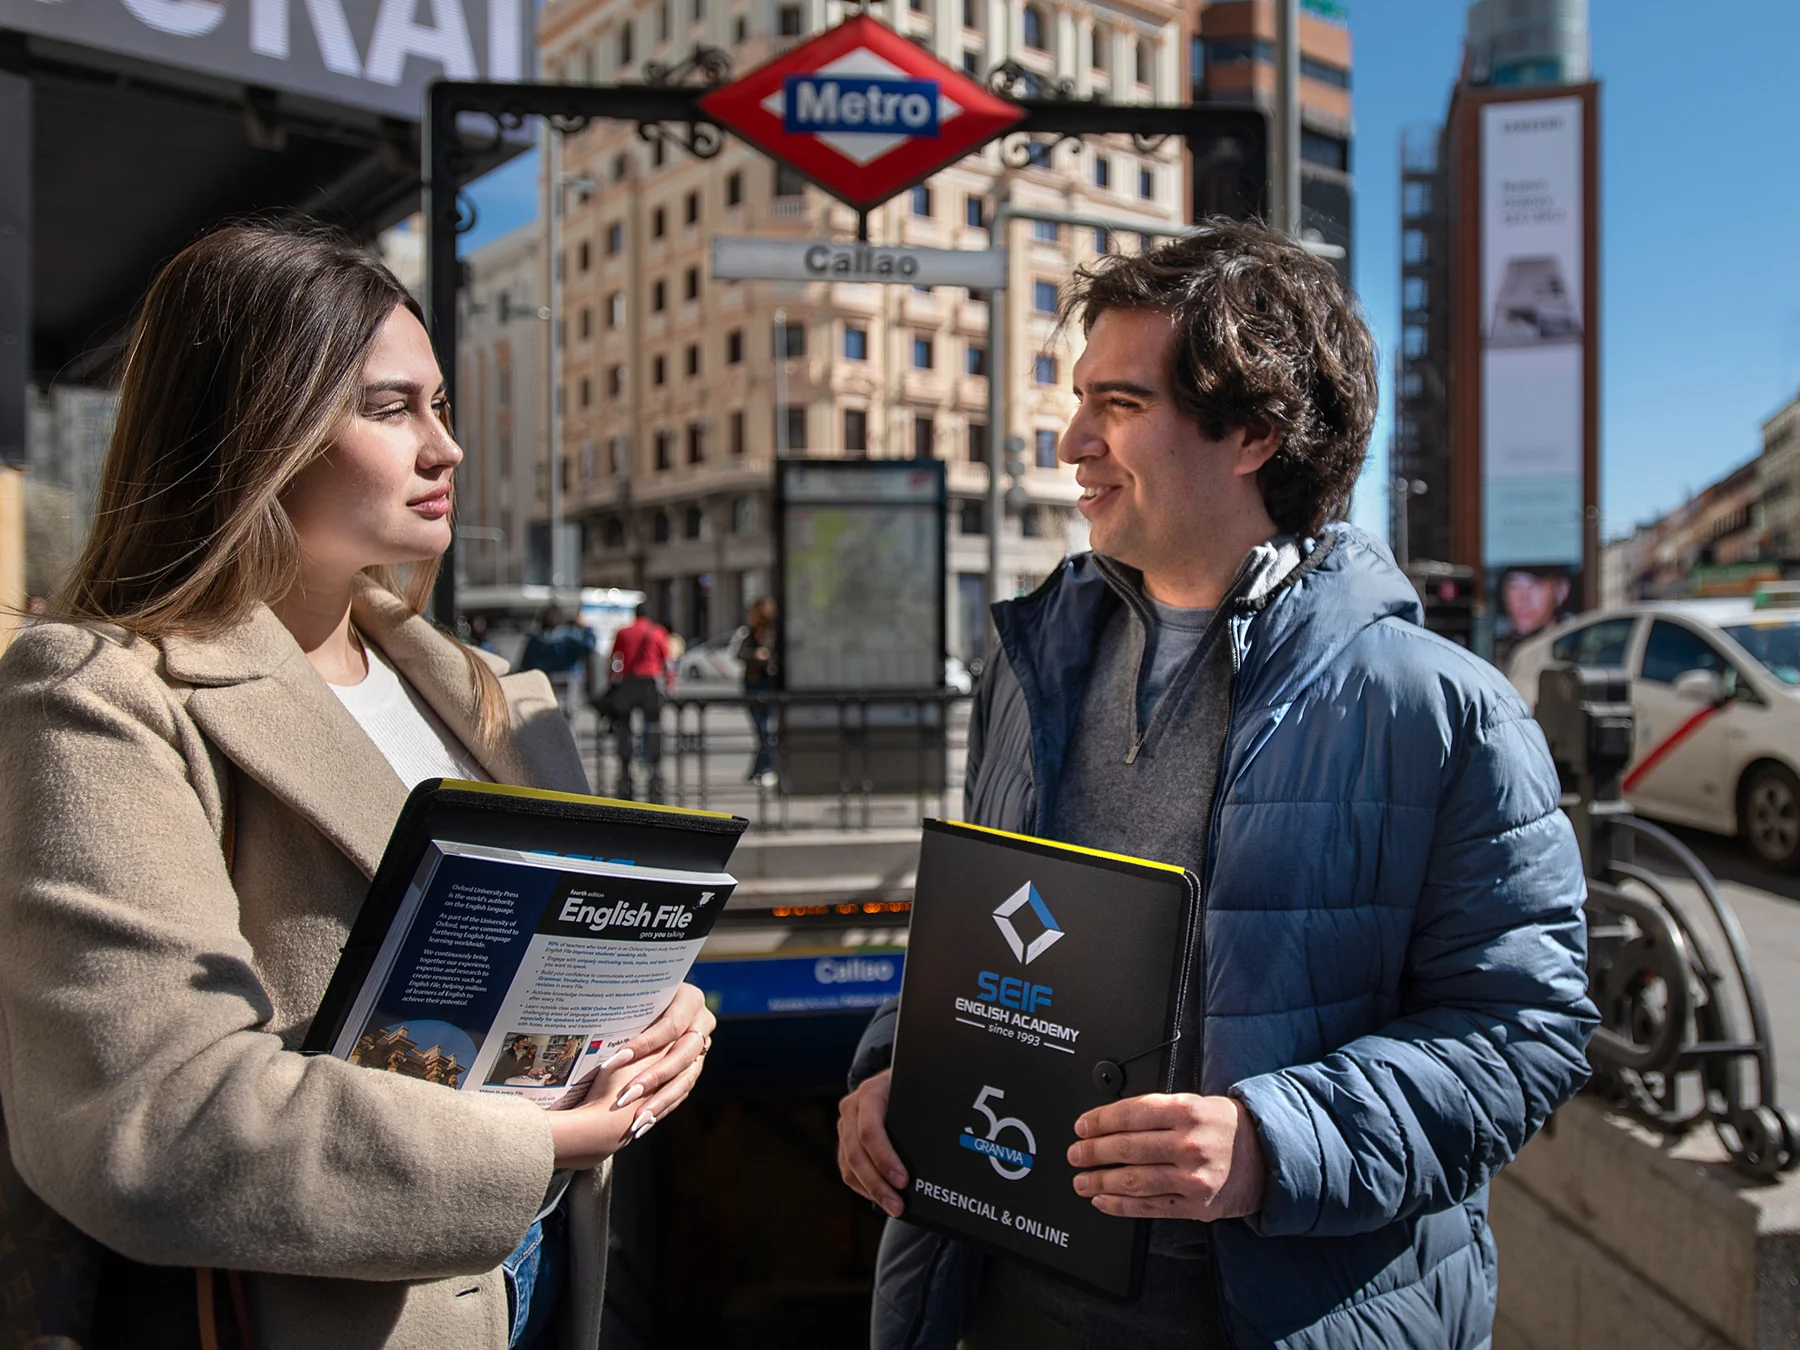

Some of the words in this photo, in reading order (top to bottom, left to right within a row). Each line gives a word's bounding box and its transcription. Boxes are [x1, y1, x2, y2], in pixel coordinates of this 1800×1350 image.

[796, 80, 931, 128] Metro
[804, 245, 919, 278] Callao
[452, 884, 474, 892] Oxford
[474, 887, 503, 897] University
[465, 902, 486, 911] English
[487, 906, 514, 914] language.
[488, 898, 515, 907] authority
[480, 918, 509, 927] University
[558, 897, 651, 931] English
[652, 905, 693, 929] File
[436, 920, 458, 929] Oxford,
[428, 936, 453, 946] learning
[432, 929, 463, 938] furthering
[485, 934, 511, 943] language
[434, 951, 472, 960] continuously
[458, 961, 490, 969] experience,
[814, 957, 894, 984] Callao
[977, 971, 1052, 1013] SEIF
[955, 998, 1010, 1023] ENGLISH
[1011, 1014, 1079, 1042] ACADEMY
[988, 1023, 1014, 1038] since
[1017, 1031, 1041, 1046] 1993
[964, 1085, 1036, 1180] 50
[915, 1179, 998, 1221] PRESENCIAL
[1001, 1211, 1012, 1226] &
[1015, 1216, 1070, 1247] ONLINE
